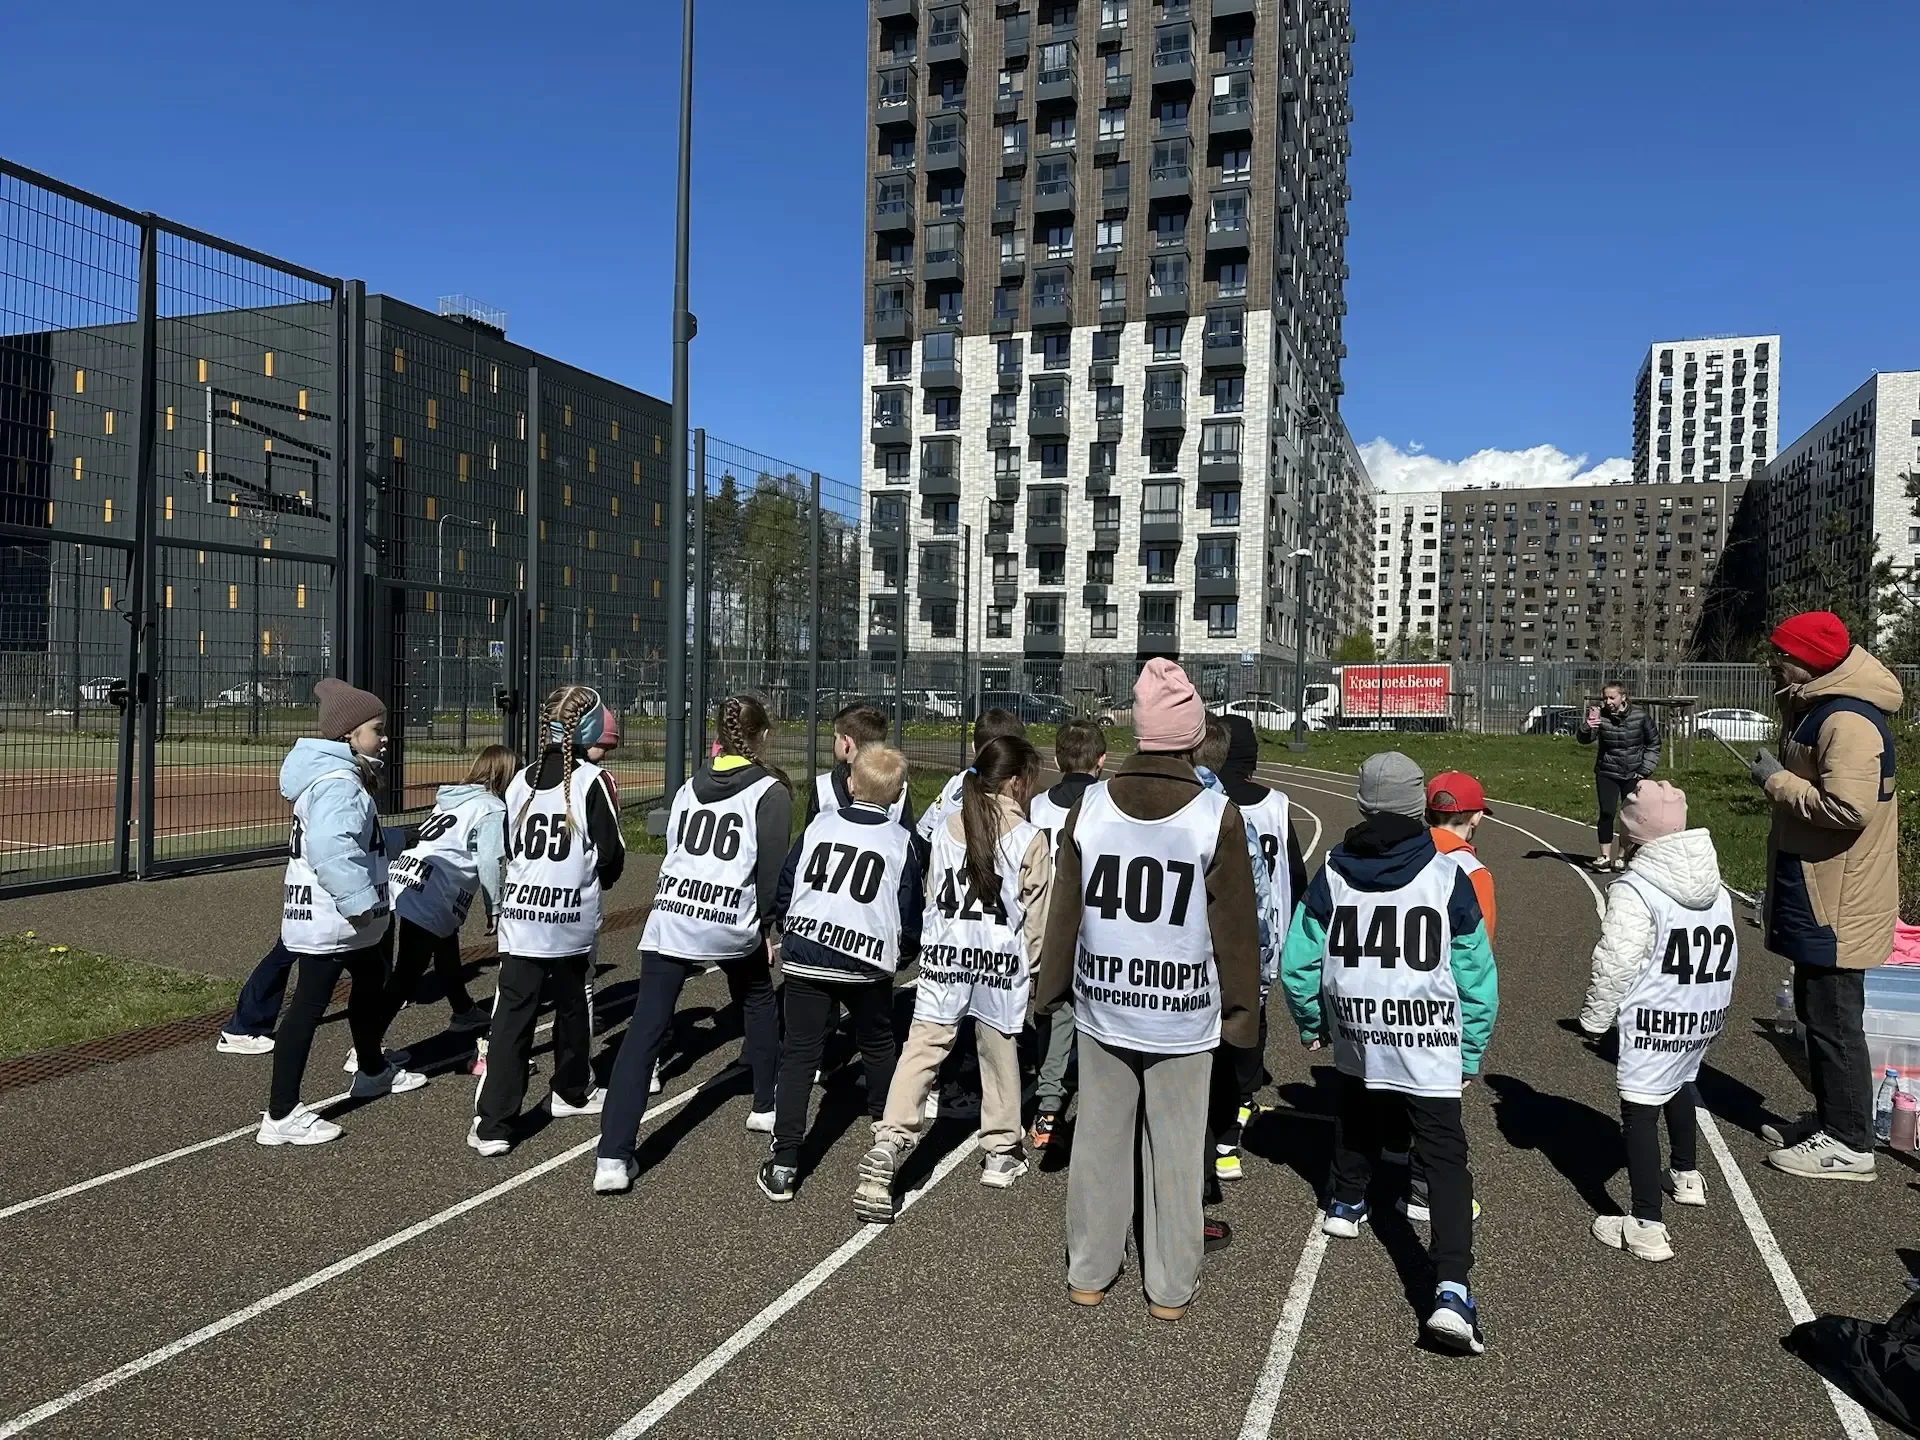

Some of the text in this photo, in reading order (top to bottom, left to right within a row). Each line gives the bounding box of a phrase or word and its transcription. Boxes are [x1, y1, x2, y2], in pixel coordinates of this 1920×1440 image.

[418, 812, 457, 841] 18
[803, 841, 886, 904] 470
[516, 884, 582, 908] СПОРТА
[677, 878, 743, 909] СПОРТА
[1085, 854, 1195, 927] 407
[538, 911, 581, 924] РАЙОНА
[696, 907, 738, 925] РАЙОНА
[817, 921, 885, 962] СПОРТА
[1329, 905, 1442, 972] 440
[1077, 943, 1210, 990] ЦЕНТР СПОРТА
[1661, 925, 1734, 985] 422
[1162, 991, 1211, 1013] РАЙОНА
[1381, 998, 1455, 1027] СПОРТА
[1636, 1008, 1698, 1036] ЦЕНТР
[1417, 1028, 1460, 1049] РАЙОН
